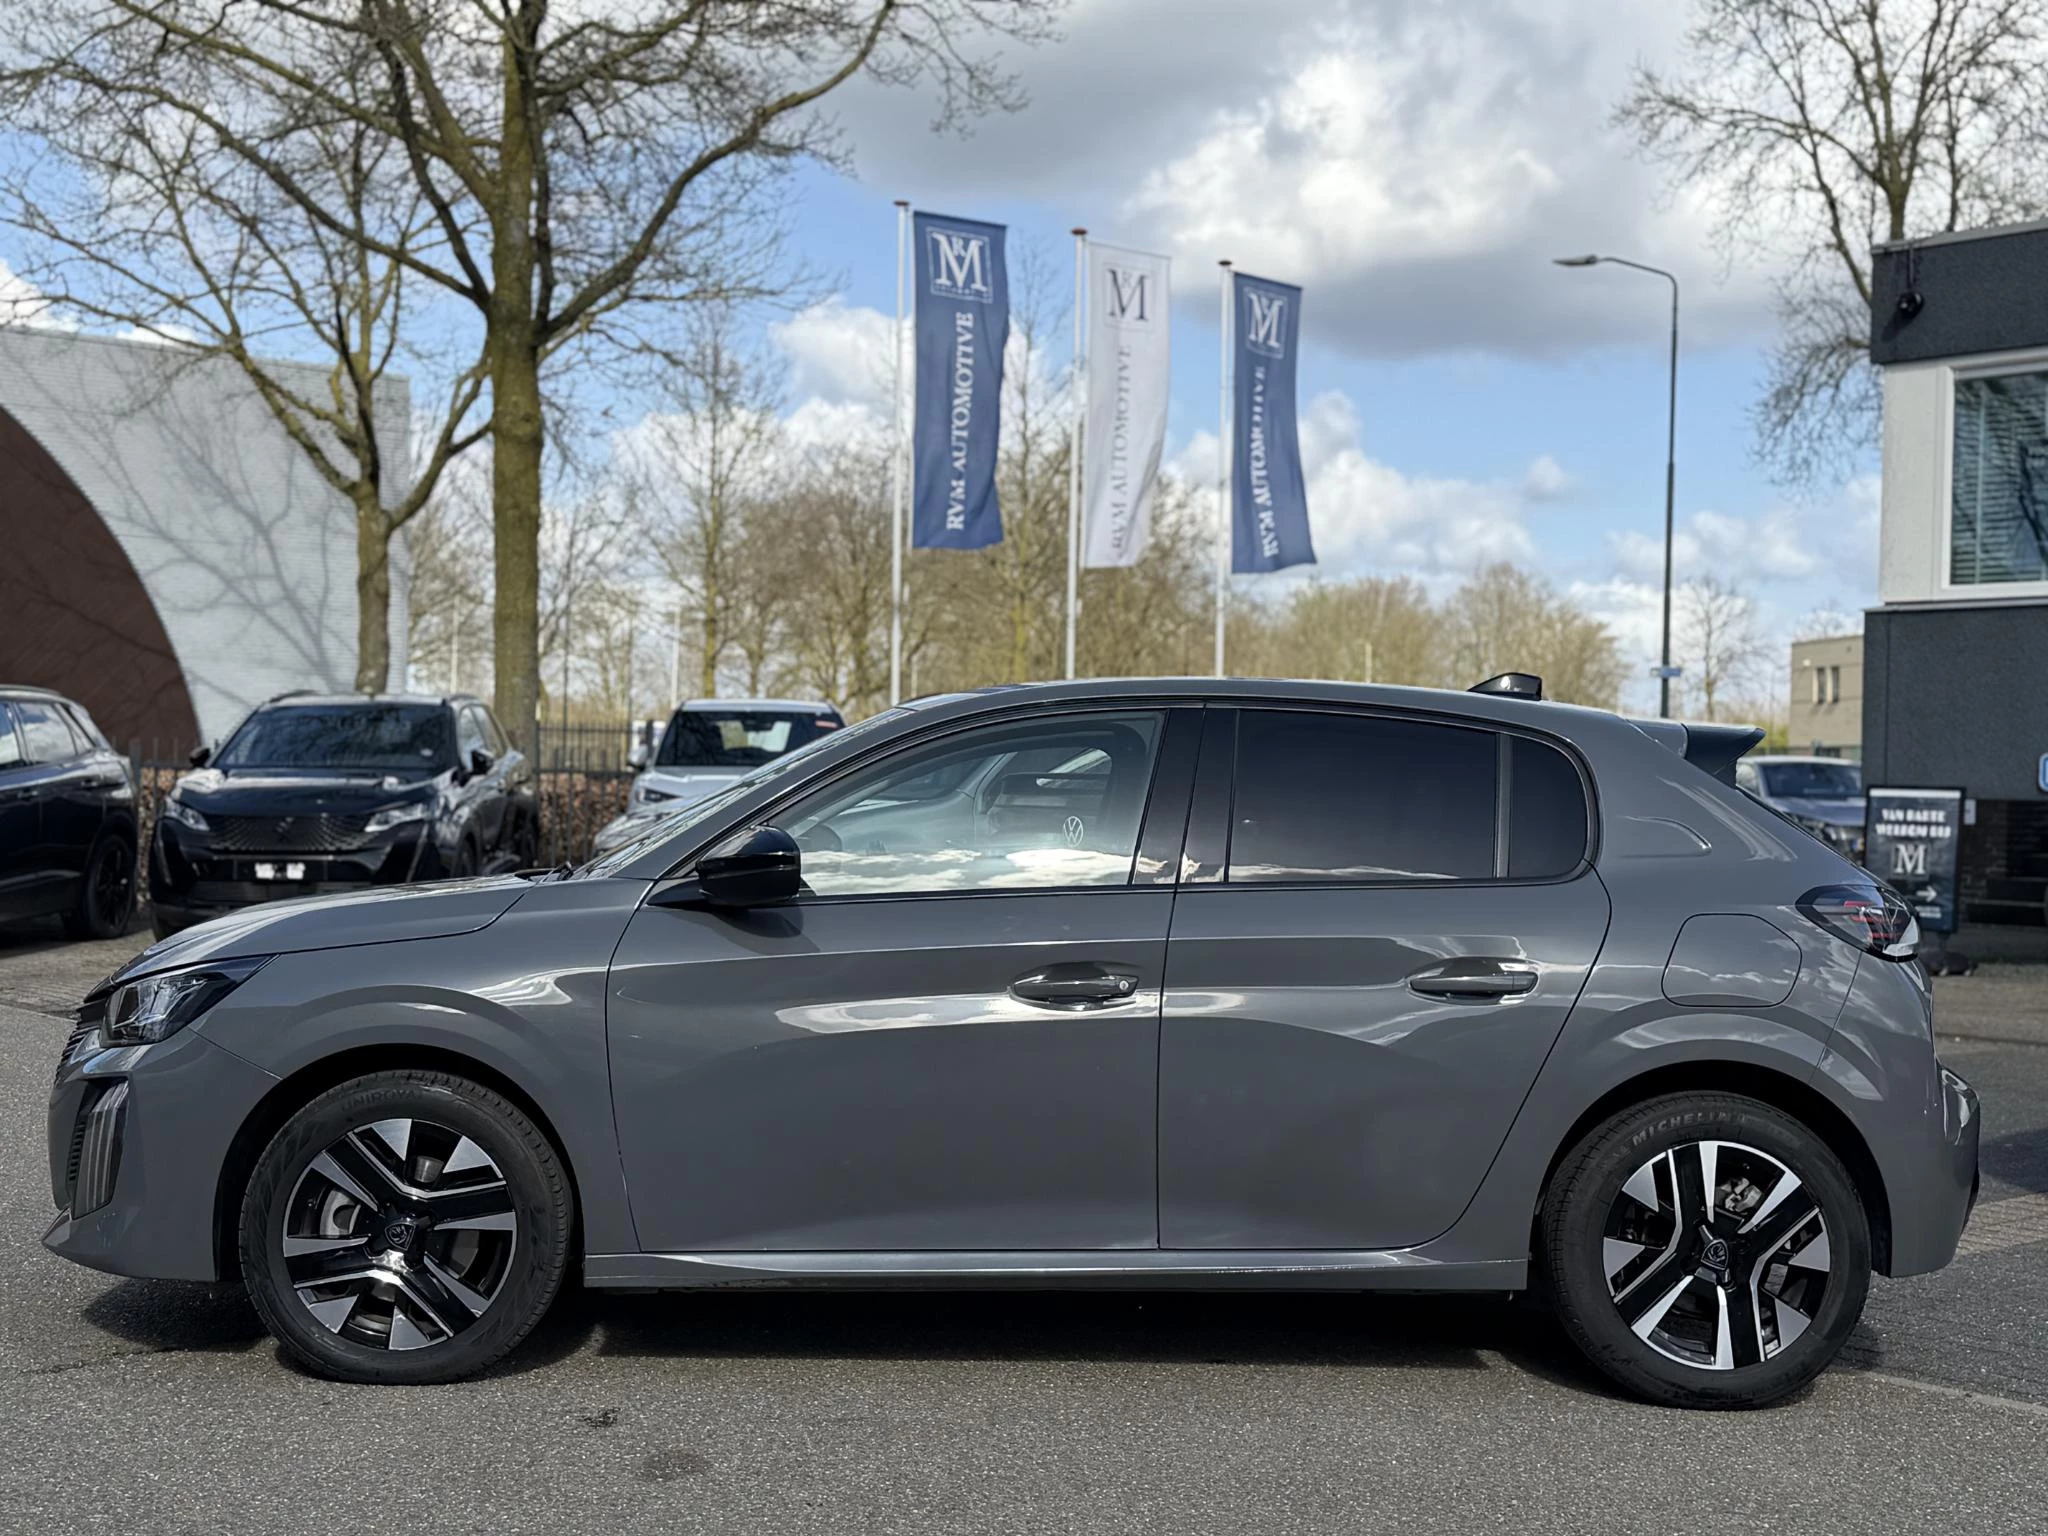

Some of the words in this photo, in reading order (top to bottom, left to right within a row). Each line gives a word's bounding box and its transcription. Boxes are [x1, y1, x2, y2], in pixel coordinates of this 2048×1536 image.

[951, 311, 974, 472] AUTOMOTIVE
[1111, 345, 1131, 495] AUTOMOTIVE
[946, 479, 966, 531] RVM
[1258, 509, 1280, 558] RVM
[342, 1088, 422, 1111] UNIROYA
[1632, 1111, 1730, 1147] MICHELIN
